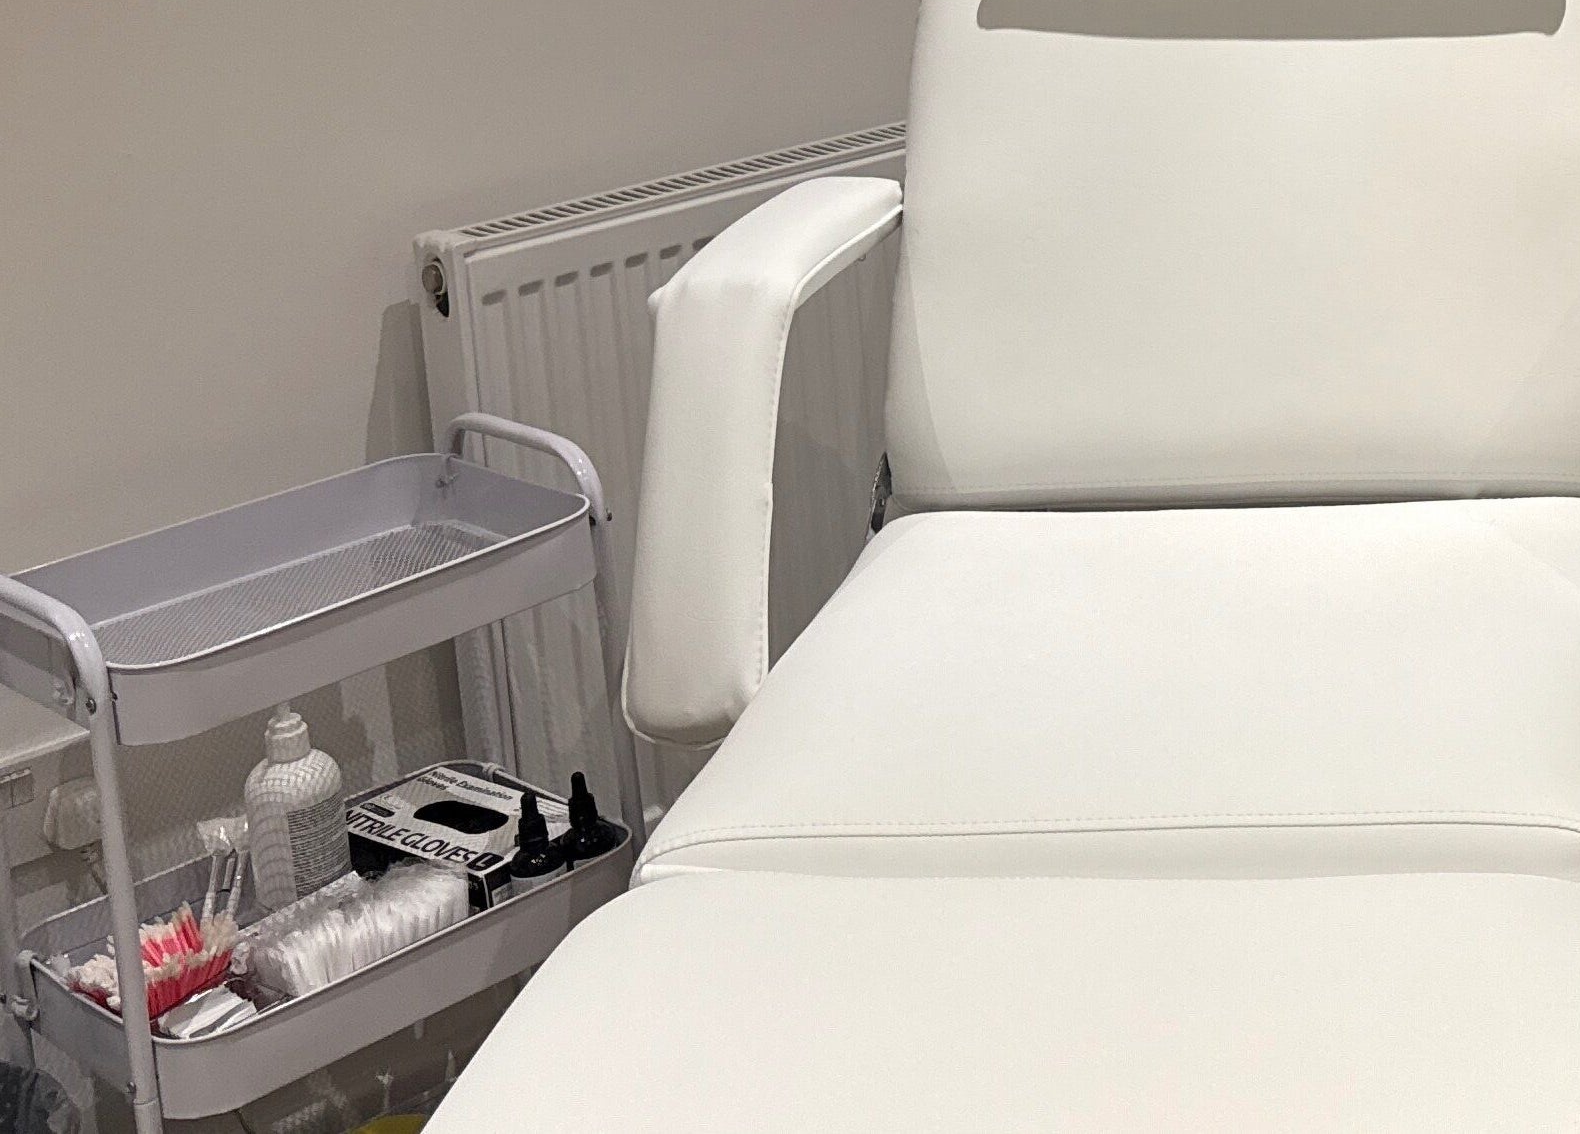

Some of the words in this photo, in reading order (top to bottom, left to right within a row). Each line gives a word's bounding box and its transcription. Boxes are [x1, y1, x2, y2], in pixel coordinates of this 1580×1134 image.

[431, 771, 458, 784] Nitrile
[456, 780, 513, 800] Examination
[346, 809, 409, 842] NITRILE
[400, 832, 478, 863] GLOVES
[477, 854, 494, 867] L
